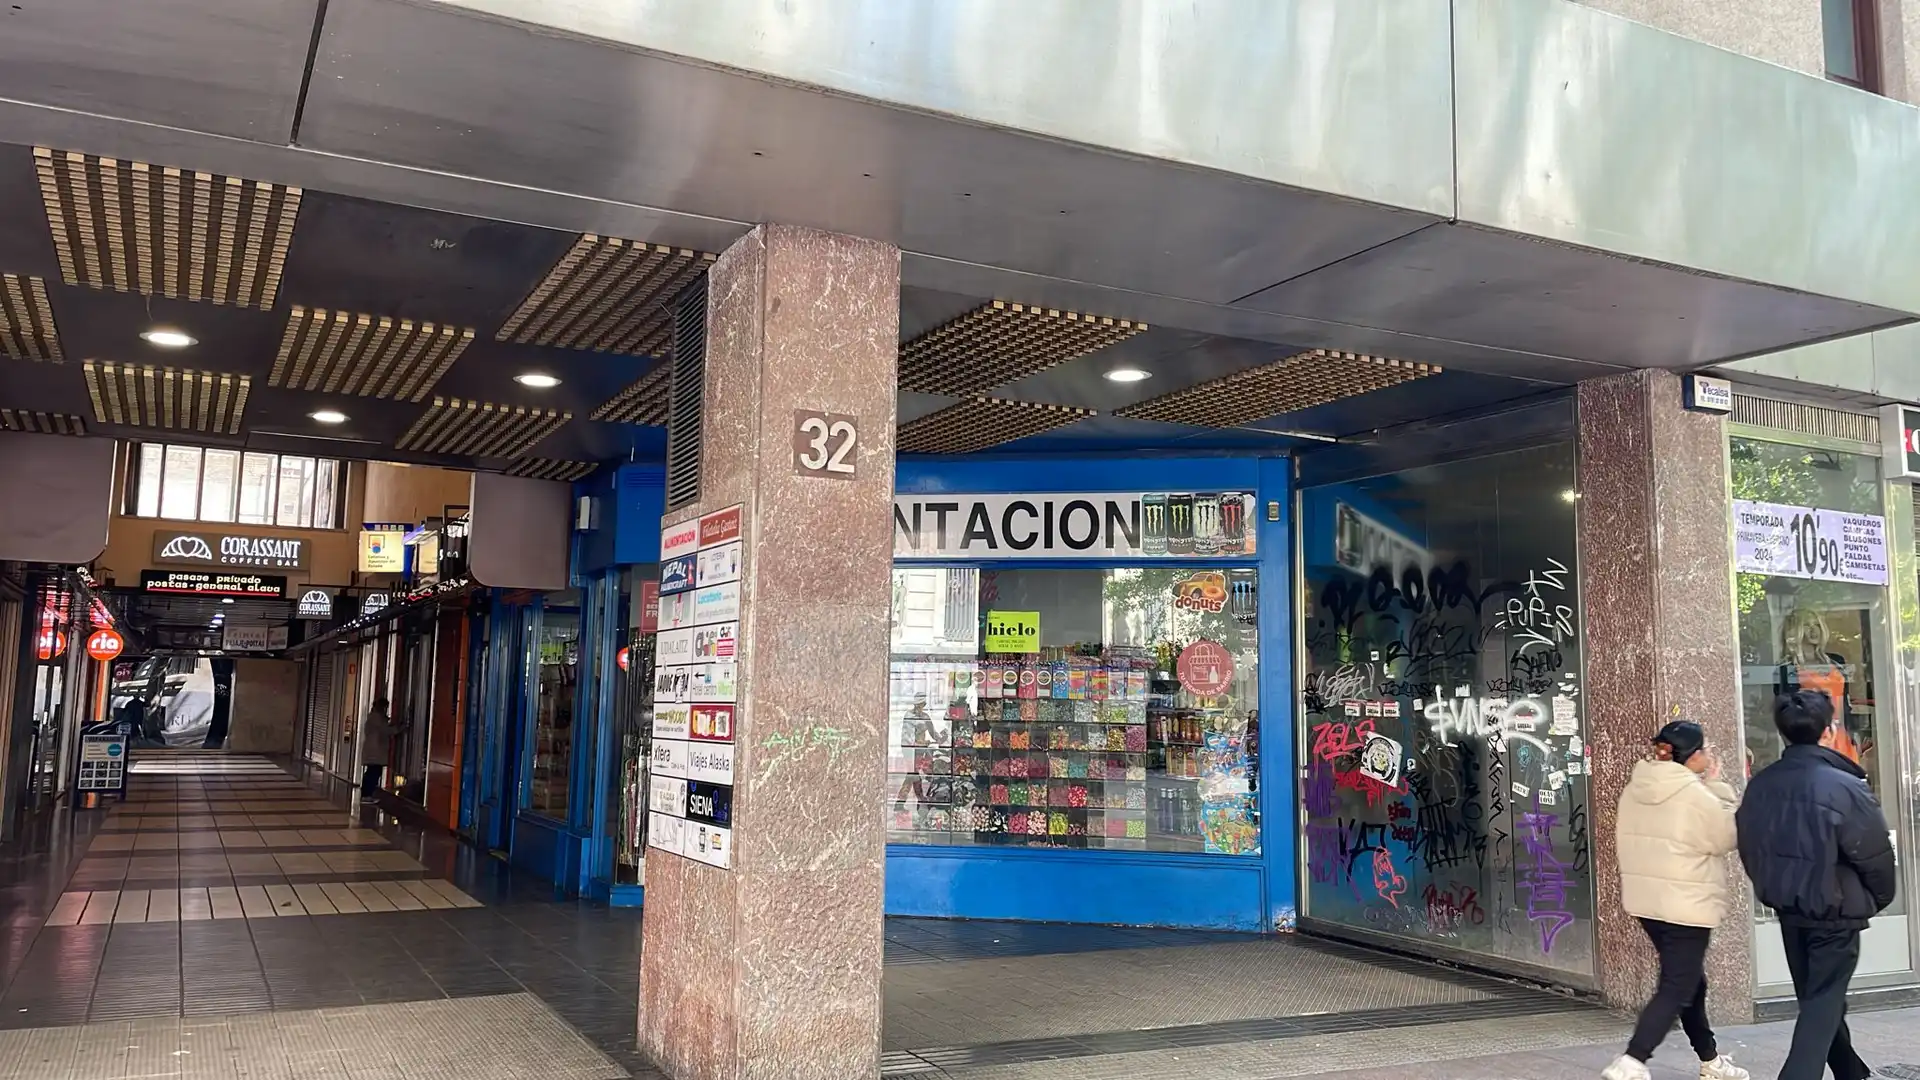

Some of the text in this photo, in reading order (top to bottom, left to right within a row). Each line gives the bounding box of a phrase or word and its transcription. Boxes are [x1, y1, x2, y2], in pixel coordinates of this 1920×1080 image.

[800, 417, 857, 473] 32
[893, 500, 1140, 550] NTACION
[1740, 512, 1784, 529] TEMPORADA
[1842, 517, 1881, 528] VAQUEROS
[220, 536, 301, 558] CORASSANT
[1843, 534, 1882, 545] BLUSONES
[1844, 543, 1869, 552] PUNTO
[220, 556, 298, 567] COFFEE BAR
[1844, 552, 1872, 561] FALDAS
[662, 560, 687, 582] NEPAL
[1845, 560, 1886, 571] CAMISETAS
[1175, 597, 1222, 612] donuts
[988, 622, 1036, 636] hielo
[91, 633, 119, 649] ria
[1184, 680, 1205, 696] TIENDA
[1215, 670, 1232, 694] BARRIO
[690, 751, 708, 772] Viajes
[708, 753, 730, 771] Alaska
[690, 794, 713, 817] SIENA
